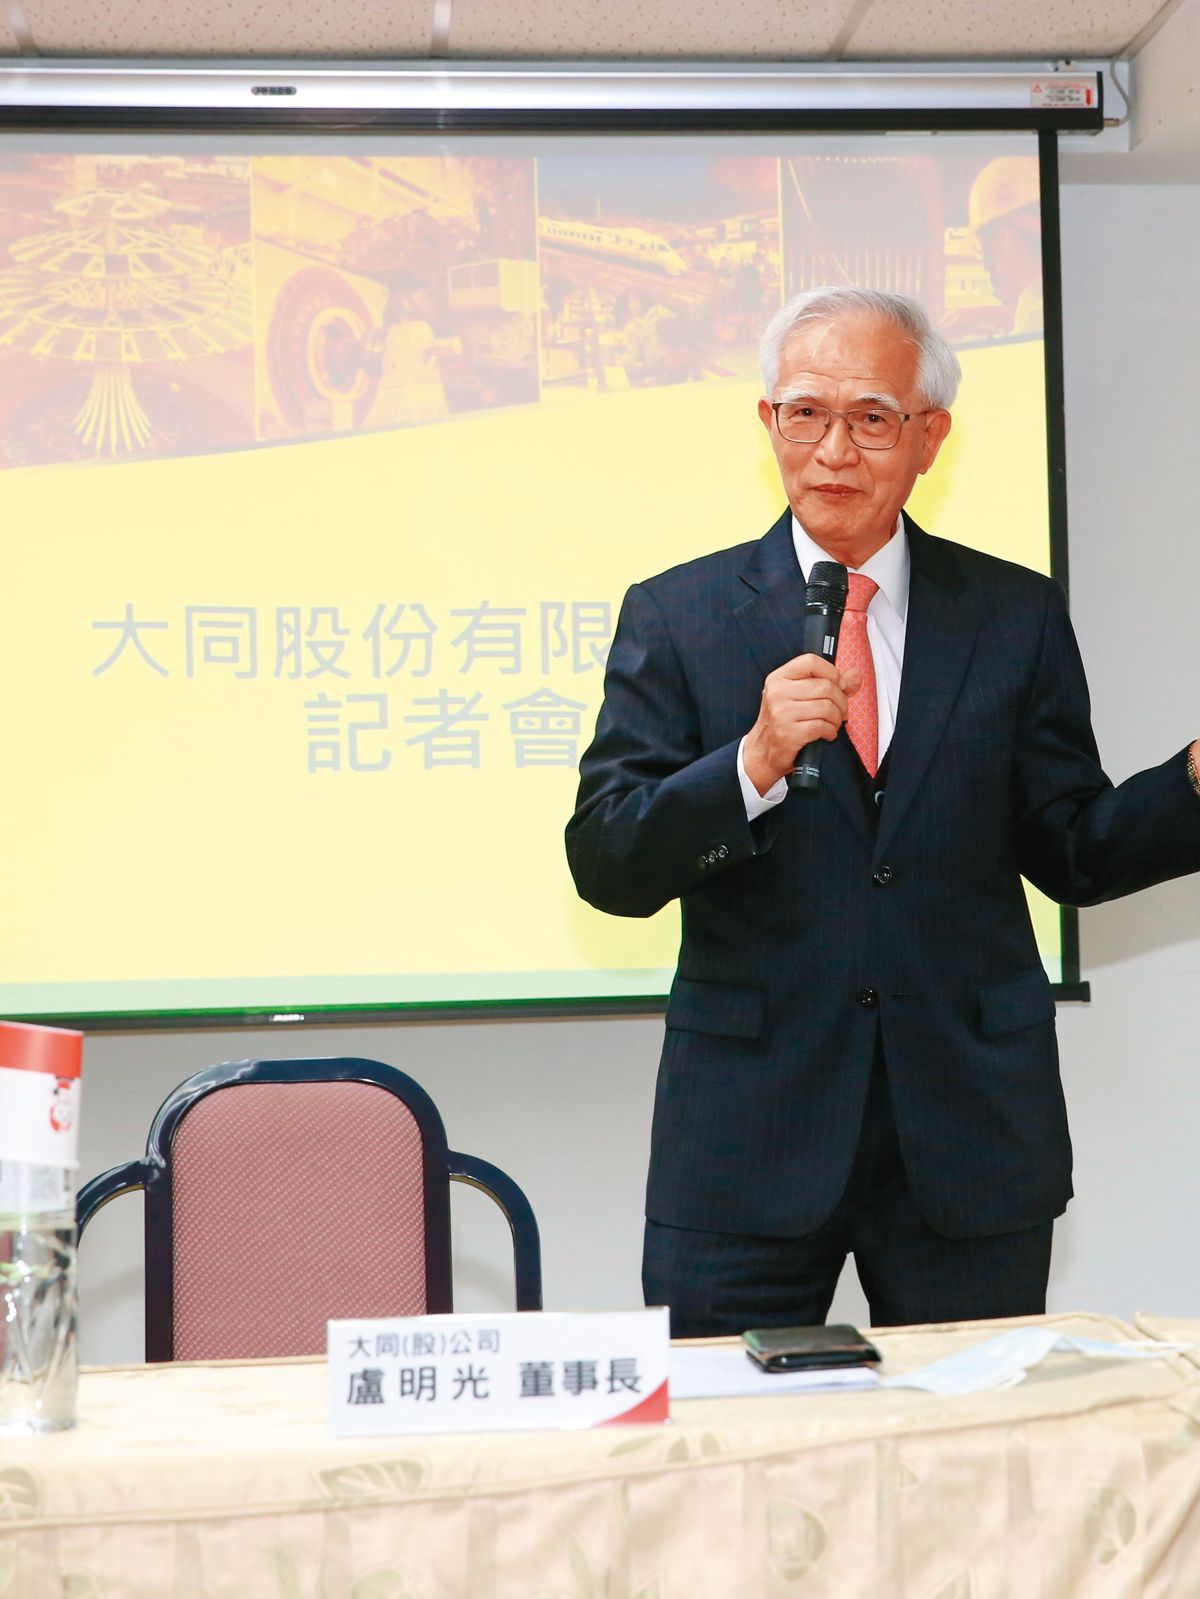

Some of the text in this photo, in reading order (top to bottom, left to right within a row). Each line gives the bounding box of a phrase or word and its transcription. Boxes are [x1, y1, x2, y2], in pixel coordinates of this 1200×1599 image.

[91, 600, 612, 680] 大同股份有限
[303, 687, 588, 774] 記者會
[348, 1329, 501, 1359] 大同(股)公司
[347, 1358, 643, 1405] 盧明光 董事長
